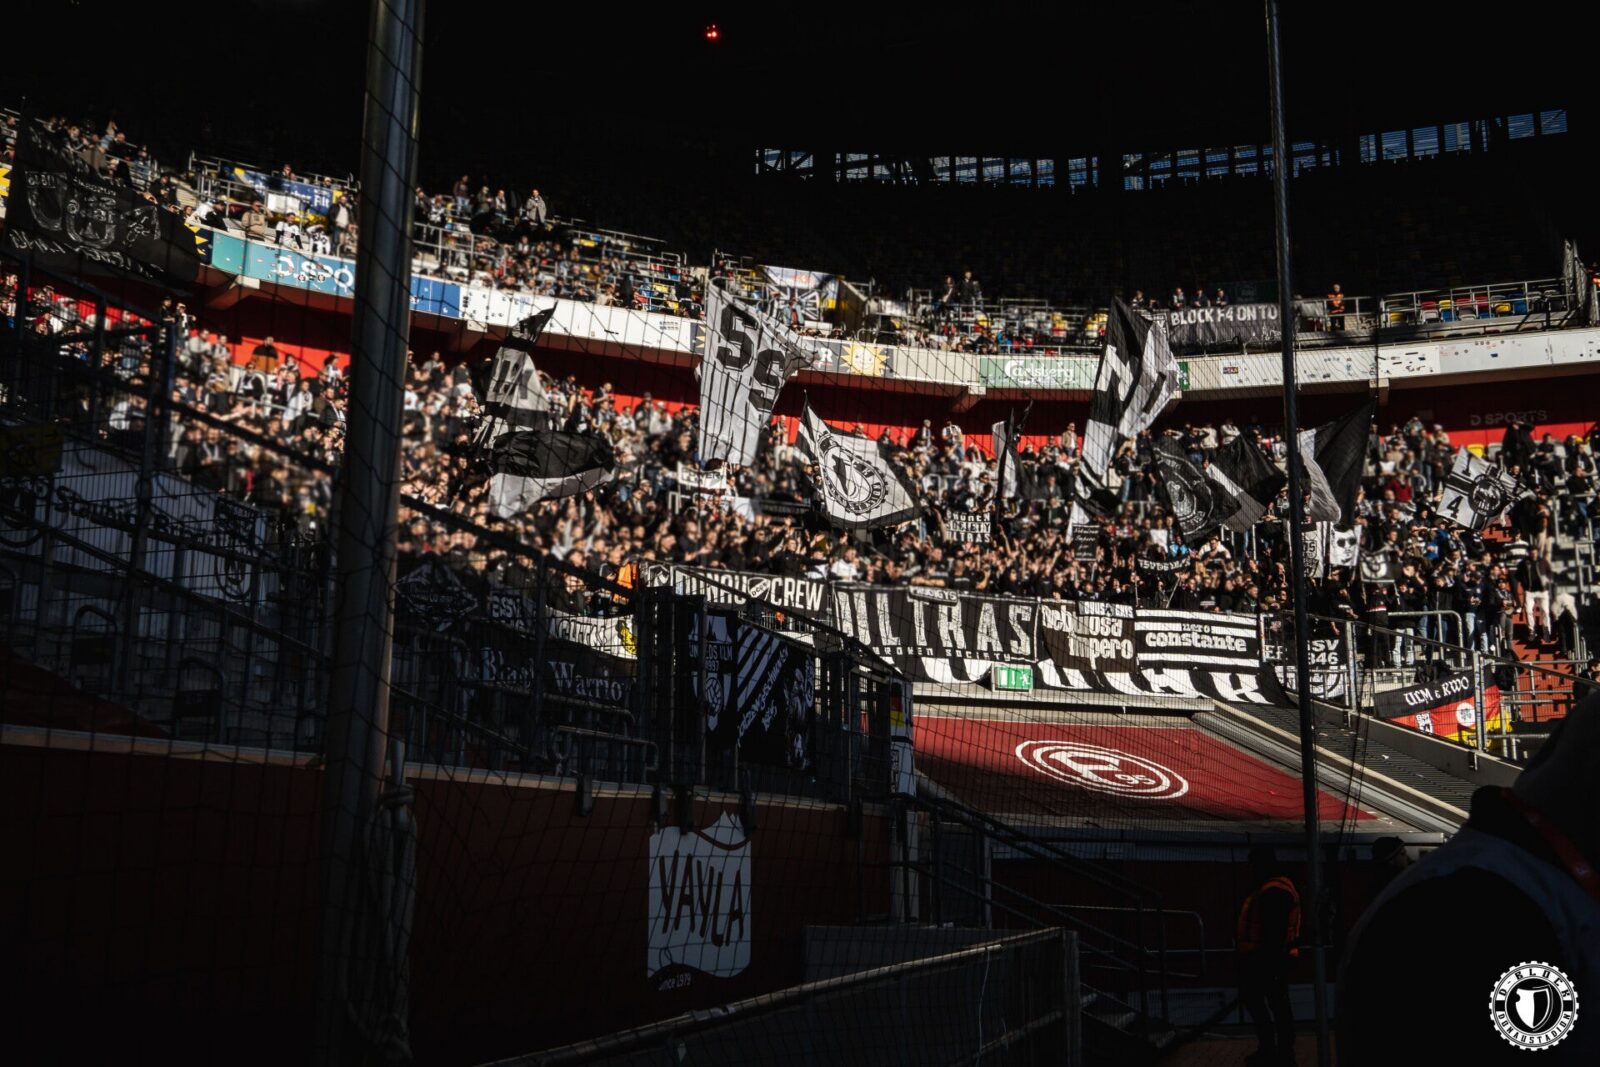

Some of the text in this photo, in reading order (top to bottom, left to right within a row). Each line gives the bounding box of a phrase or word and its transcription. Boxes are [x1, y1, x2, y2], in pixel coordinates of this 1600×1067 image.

[1170, 308, 1215, 326] BLOCK
[1216, 306, 1234, 322] F4
[1236, 305, 1257, 321] ON
[1004, 359, 1075, 385] Carlsberg
[770, 577, 824, 612] CREW
[837, 589, 1033, 657] ULTRAS
[1145, 631, 1247, 652] constante
[944, 647, 1011, 662] SOCIETY
[1441, 676, 1469, 697] RWO
[659, 850, 744, 947] YAYLA
